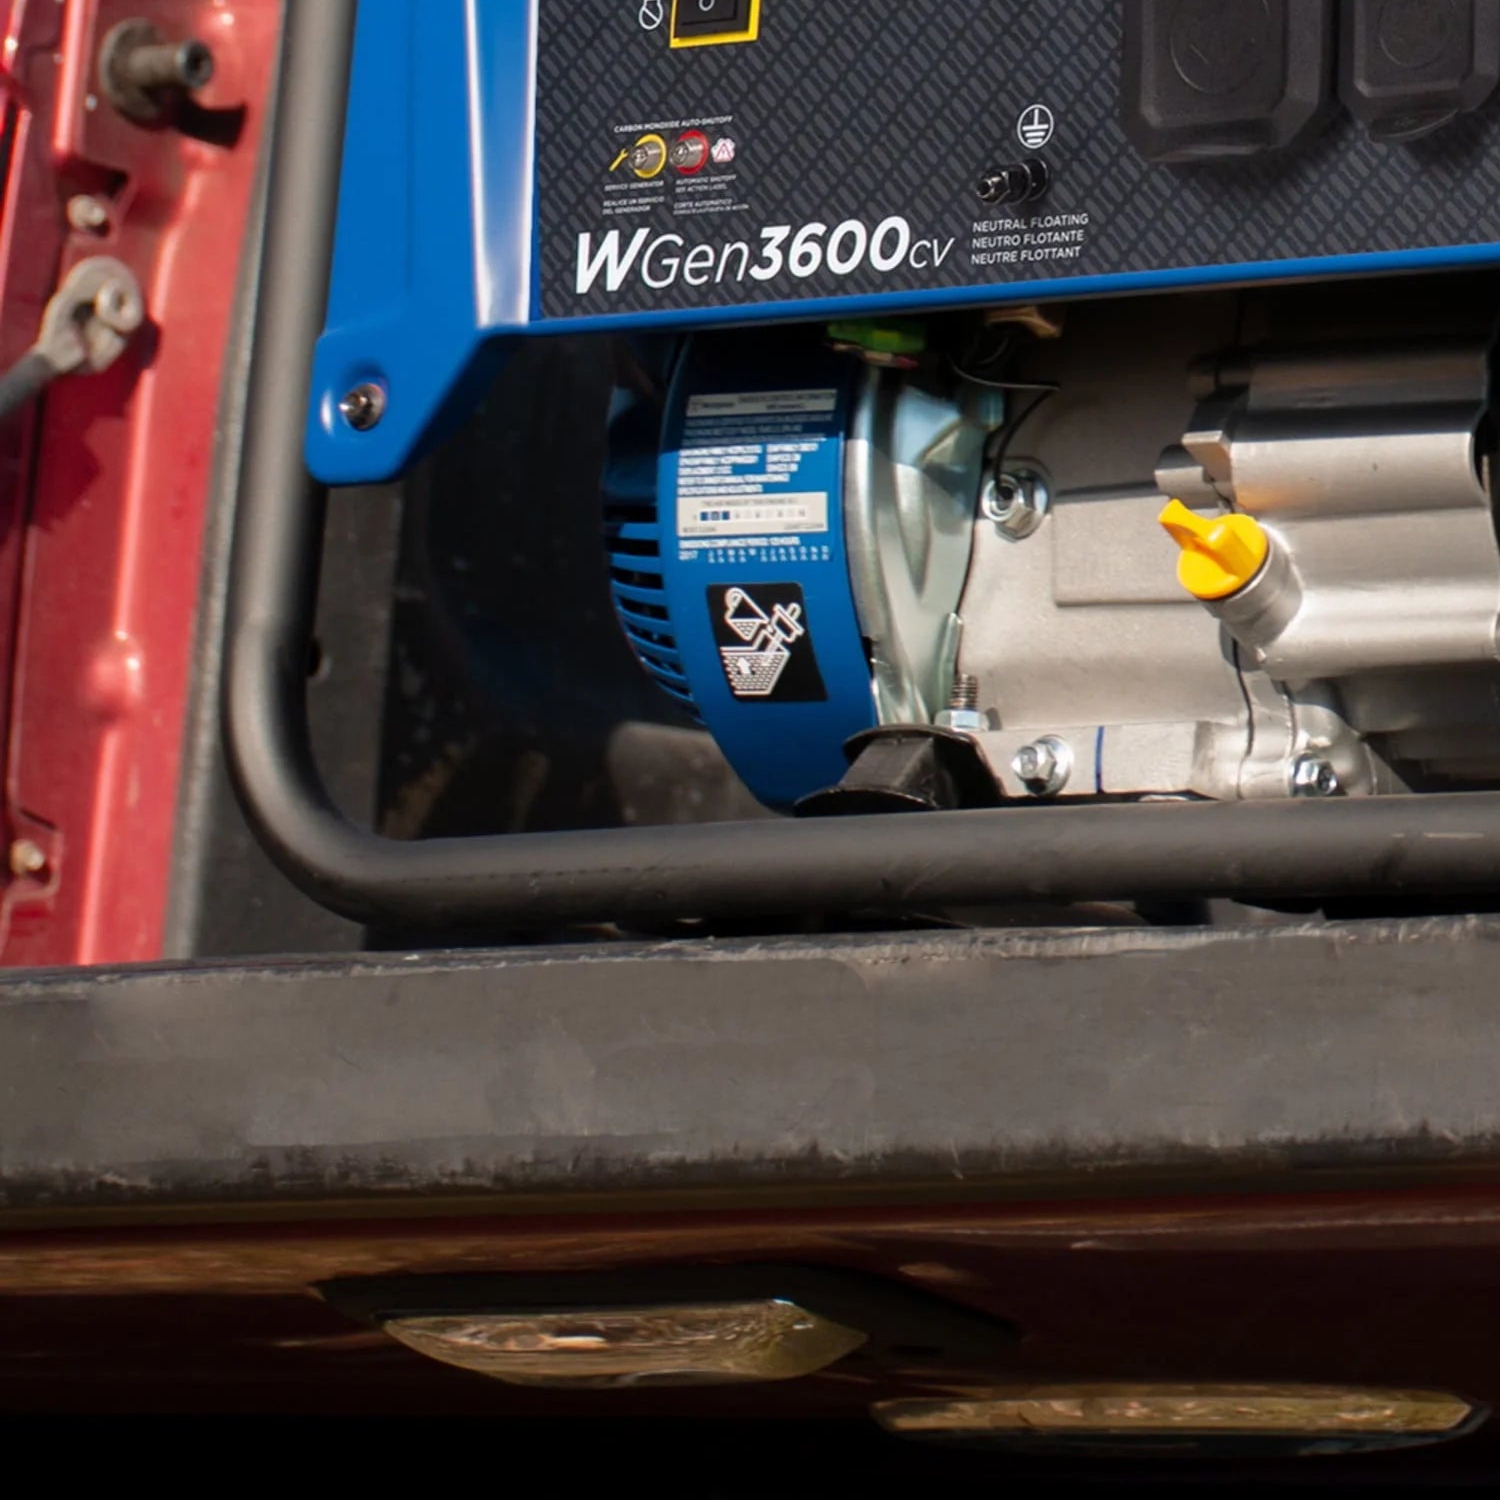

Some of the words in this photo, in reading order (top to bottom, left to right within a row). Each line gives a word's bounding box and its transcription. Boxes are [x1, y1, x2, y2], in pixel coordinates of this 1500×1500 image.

[613, 123, 643, 133] CARBON
[644, 120, 680, 130] MONOXIDE
[972, 219, 1027, 233] NEUTRAL
[1030, 213, 1089, 229] FLOATING
[971, 234, 1021, 249] NEUTRO
[1023, 229, 1085, 245] FLOTANTE
[970, 250, 1018, 265] NEUTRE
[1020, 245, 1081, 261] FLOTTANT
